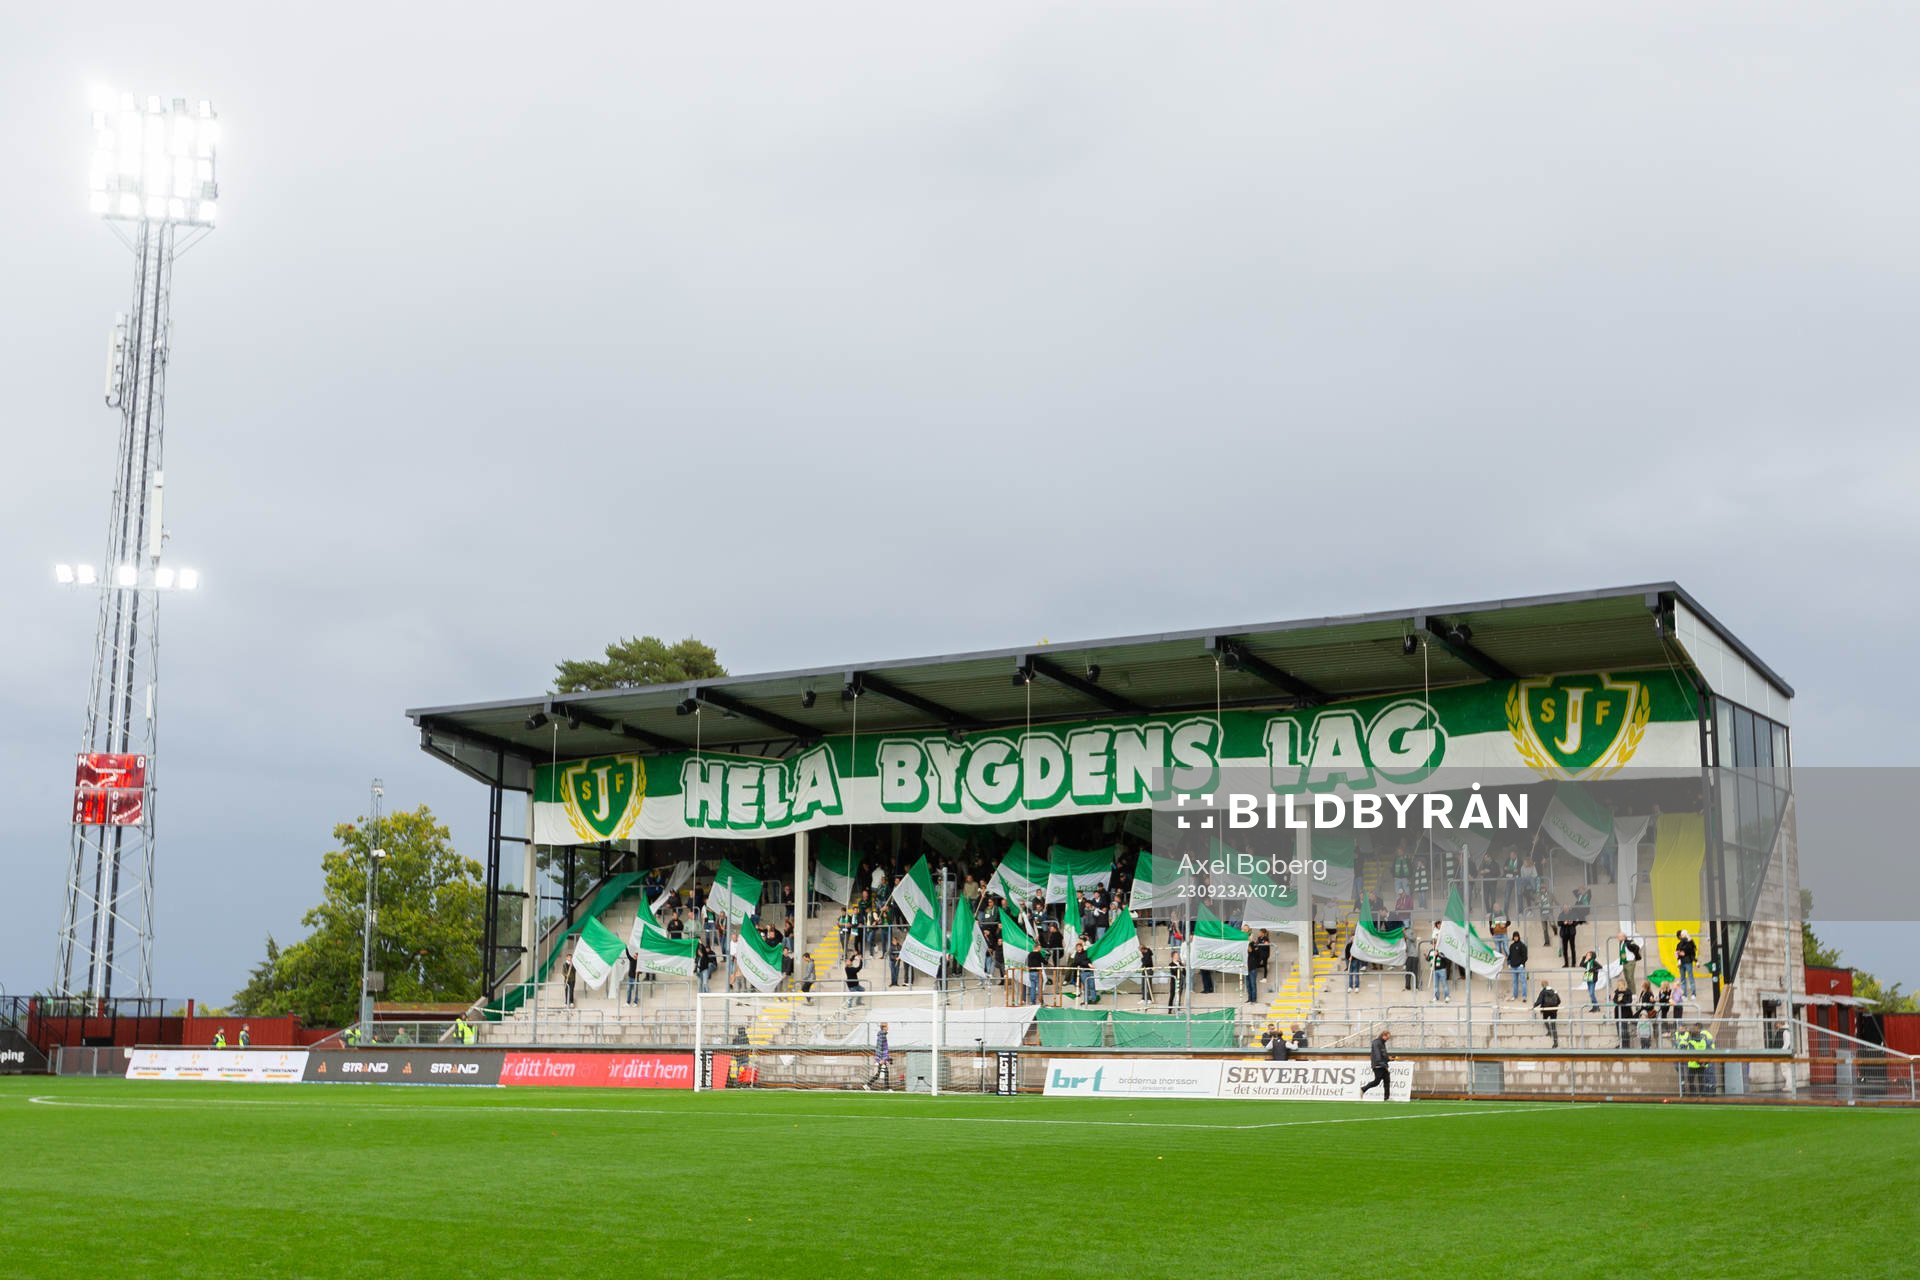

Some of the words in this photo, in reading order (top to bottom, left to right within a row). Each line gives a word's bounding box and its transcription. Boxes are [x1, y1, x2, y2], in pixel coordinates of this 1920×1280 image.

[683, 744, 843, 829] HELA
[879, 717, 1221, 813] BYGDENS
[1264, 699, 1447, 794] LAG
[0, 1049, 25, 1064] ping
[342, 1061, 389, 1073] STRAND
[430, 1062, 479, 1074] STRAND
[515, 1058, 541, 1077] ditt
[543, 1058, 576, 1077] hem
[623, 1059, 651, 1078] ditt
[653, 1059, 688, 1079] hem
[999, 1056, 1009, 1091] SELECT
[1227, 1066, 1356, 1085] SEVERINS
[1233, 1085, 1250, 1095] det
[1253, 1086, 1279, 1096] stora
[1282, 1085, 1344, 1096] möbelhuset
